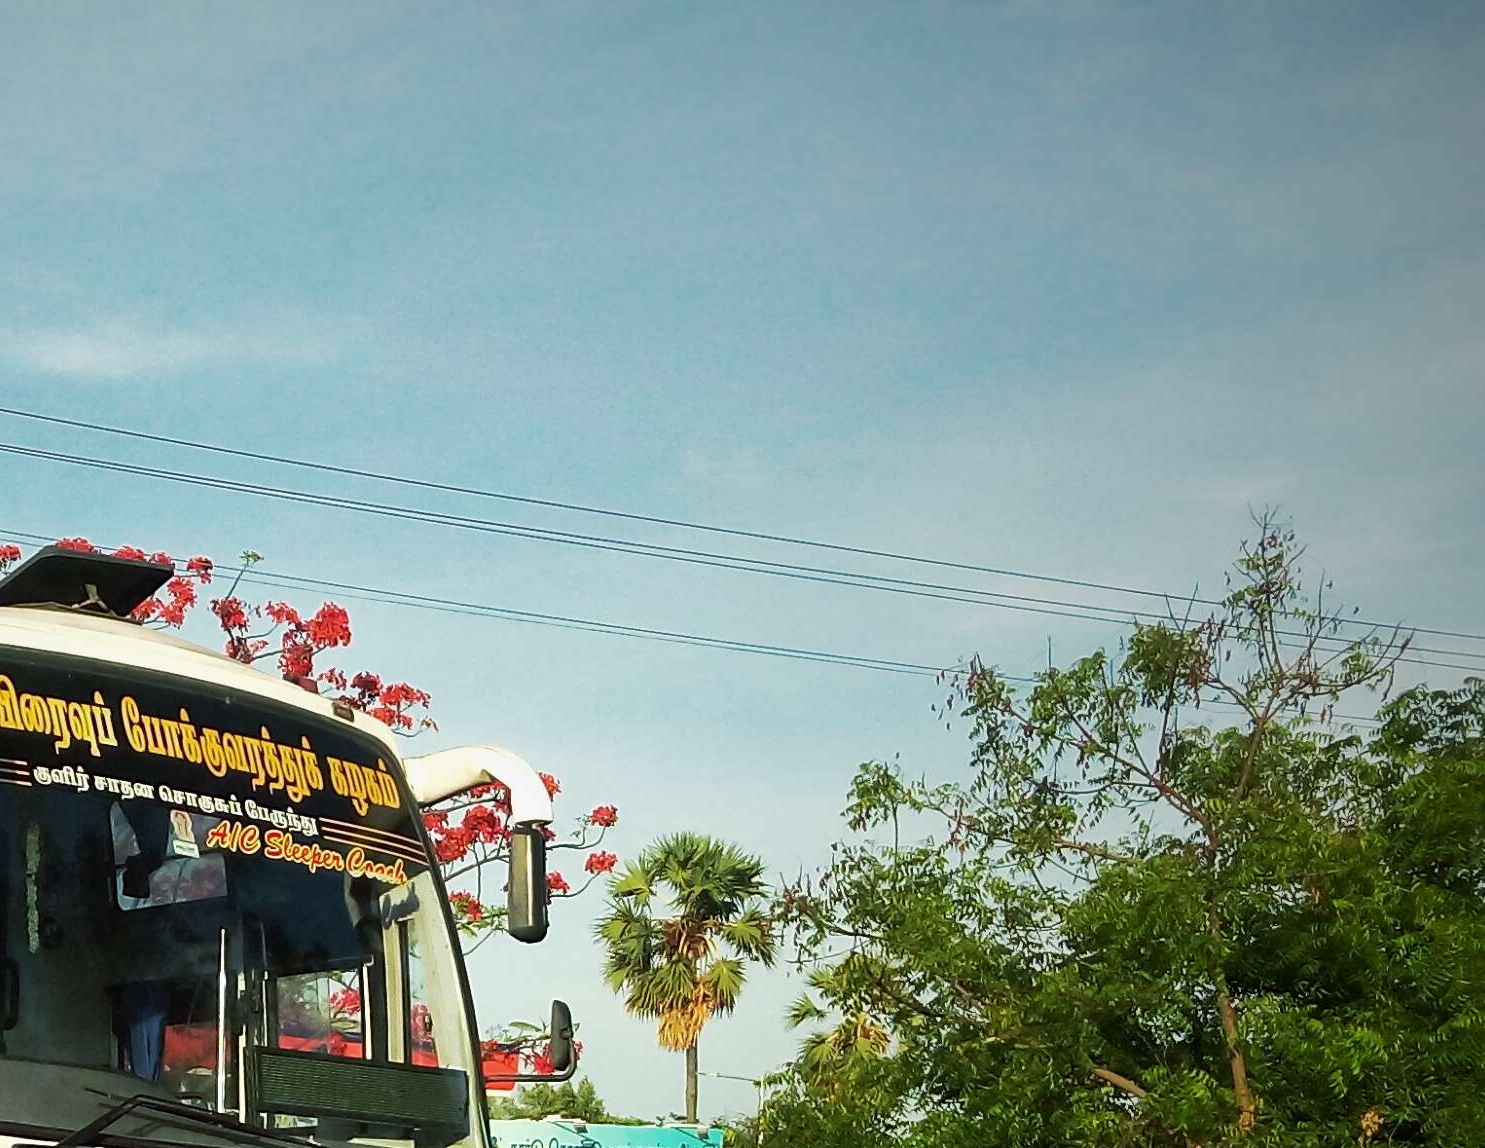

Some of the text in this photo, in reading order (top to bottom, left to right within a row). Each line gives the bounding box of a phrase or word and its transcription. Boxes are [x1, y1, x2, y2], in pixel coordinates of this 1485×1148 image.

[121, 696, 324, 803] போக்குவரத்துக்
[327, 757, 401, 816] கழகம்
[33, 765, 89, 792] குளிர்
[94, 775, 154, 800] சாதன
[244, 797, 319, 836] பேருந்து
[206, 820, 409, 886] A/C Sleeper Coach
